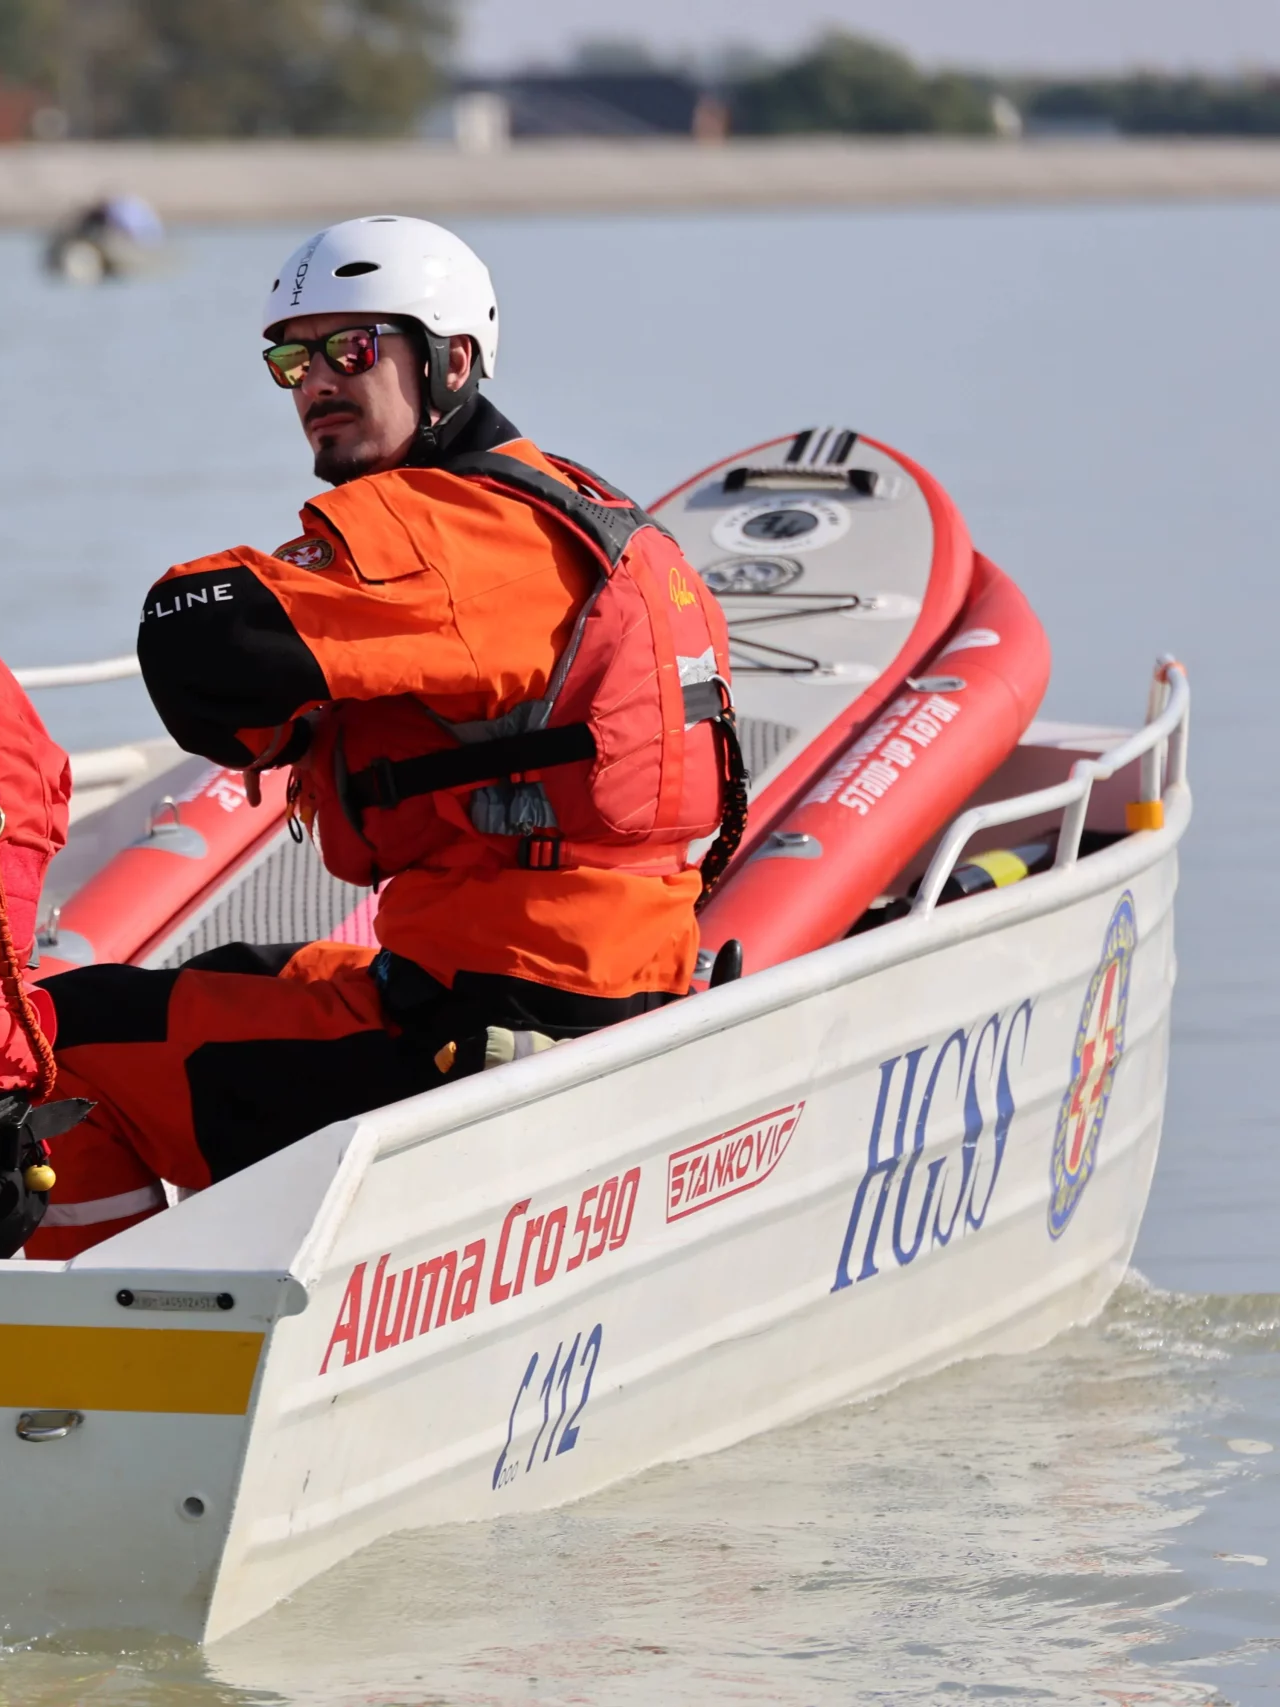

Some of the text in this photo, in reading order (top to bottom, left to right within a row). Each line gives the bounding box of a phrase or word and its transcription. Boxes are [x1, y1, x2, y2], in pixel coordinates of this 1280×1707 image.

[318, 1166, 641, 1376] Aluma Cro 590
[830, 997, 1039, 1294] HGSS
